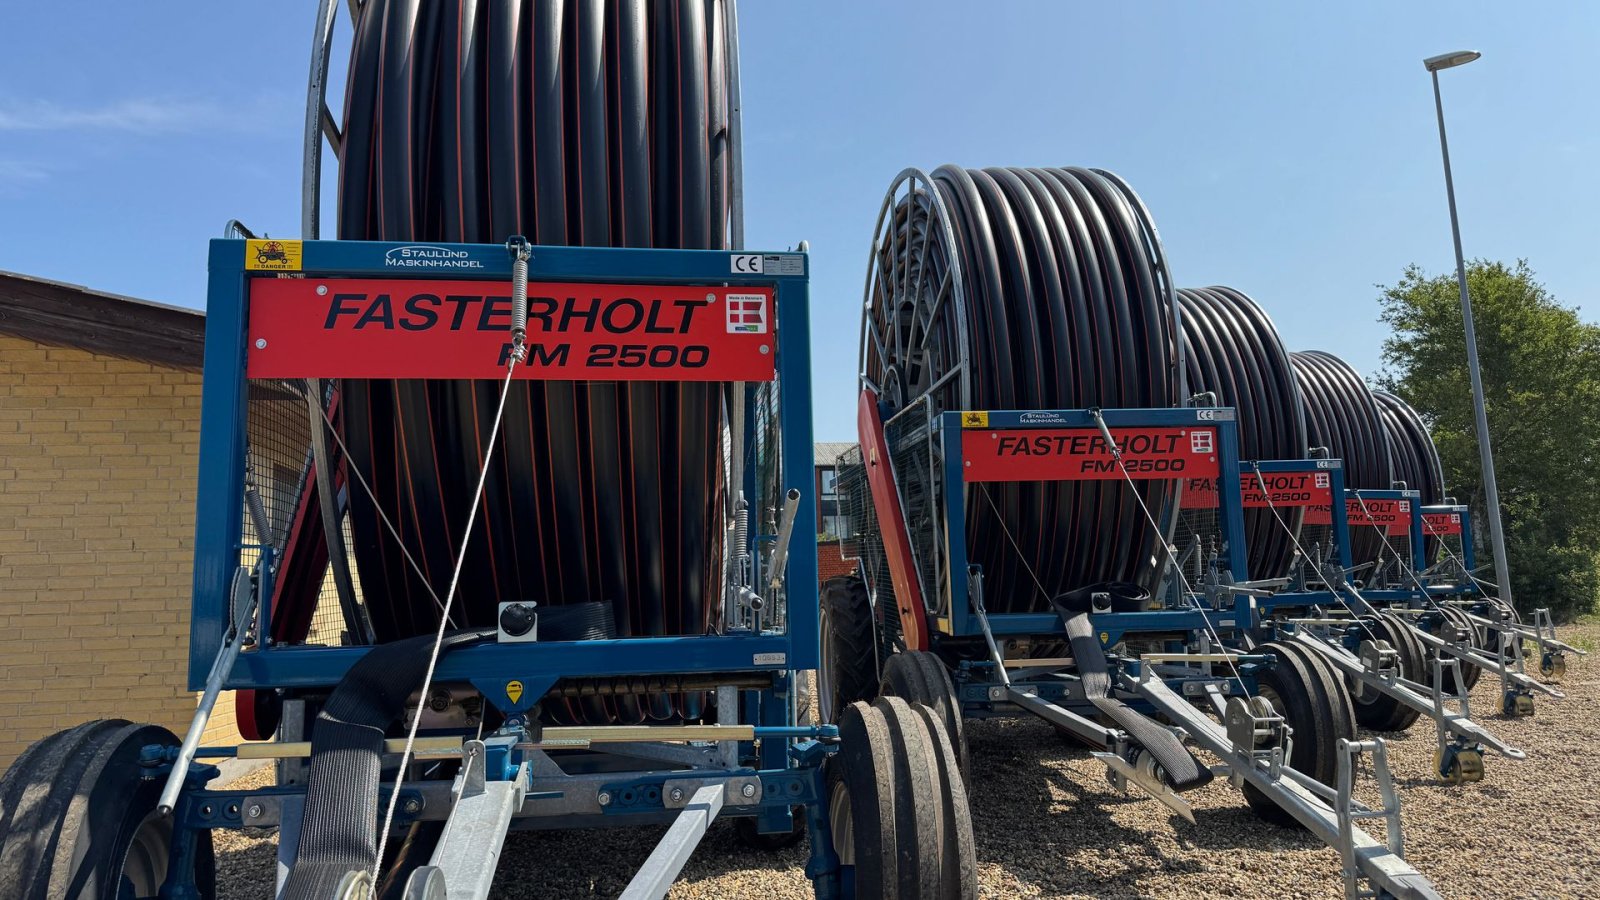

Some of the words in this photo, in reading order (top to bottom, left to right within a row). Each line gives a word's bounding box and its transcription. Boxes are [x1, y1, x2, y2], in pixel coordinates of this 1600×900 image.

[401, 248, 469, 259] STAULUND
[385, 257, 484, 268] MASKINHANDEL
[736, 256, 758, 272] CE
[323, 293, 709, 335] FASTERHOLT
[497, 343, 571, 367] FM
[586, 344, 710, 368] 2500
[1199, 411, 1211, 419] CE
[997, 434, 1184, 456] FASTERHOLT
[1080, 459, 1115, 473] FM
[1124, 458, 1185, 472] 2500
[1244, 493, 1266, 502] FM
[1271, 492, 1311, 502] 2500
